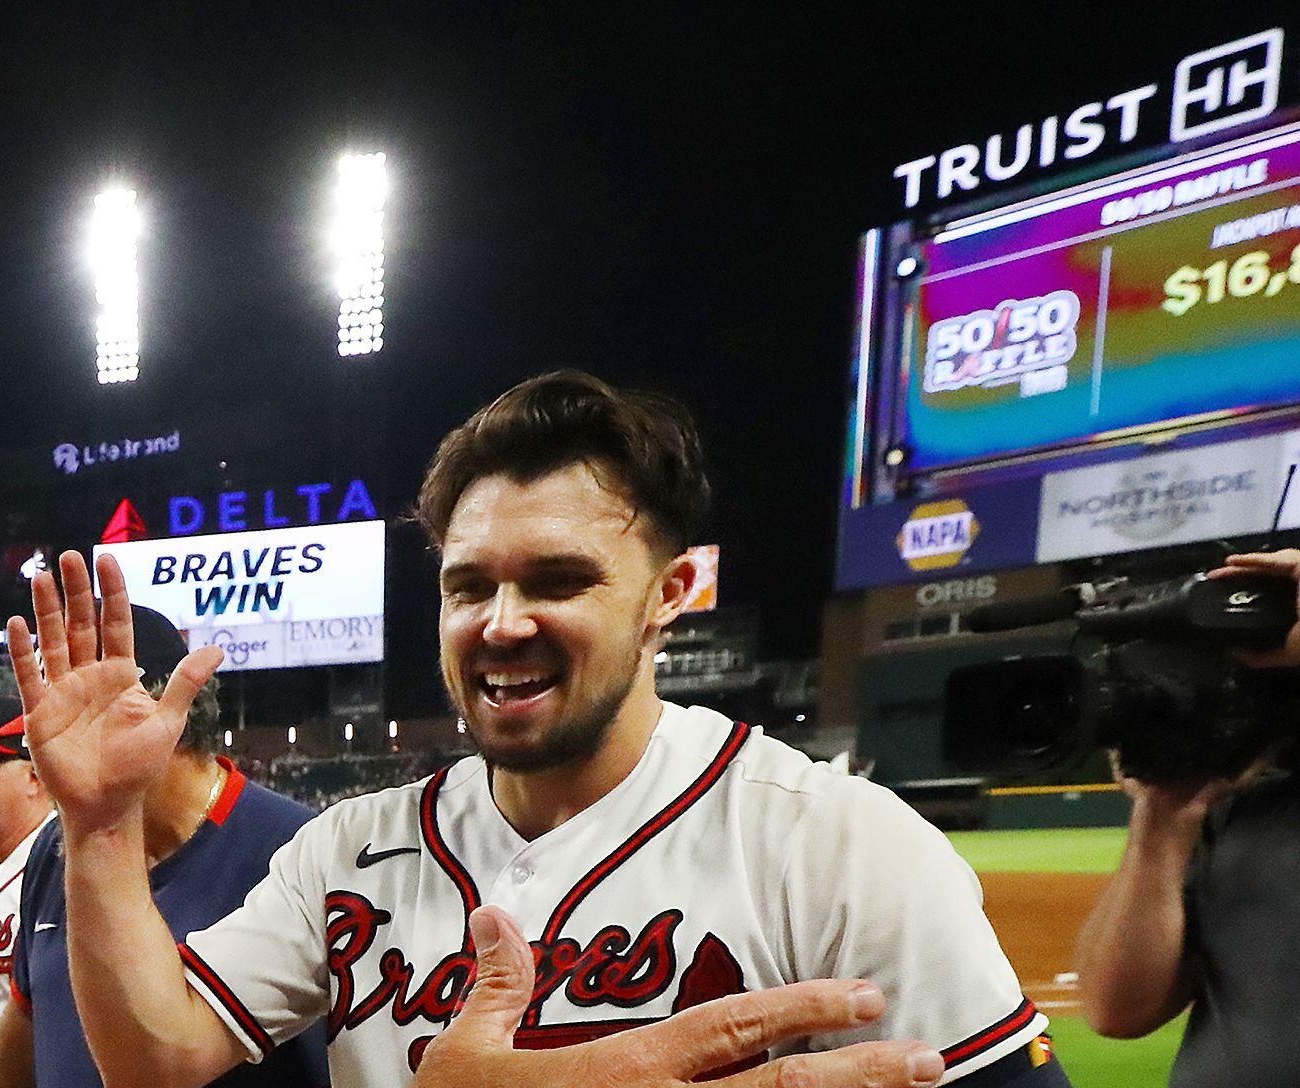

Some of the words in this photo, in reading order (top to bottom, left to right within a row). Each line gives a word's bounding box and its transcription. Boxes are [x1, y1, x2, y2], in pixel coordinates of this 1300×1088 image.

[893, 84, 1158, 208] TRUIST
[1161, 243, 1300, 317] $16,
[935, 298, 1072, 361] 50/50
[168, 479, 378, 536] DELTA
[911, 518, 967, 551] NAPA
[152, 543, 326, 585] BRAVES
[195, 581, 284, 616] WIN
[290, 616, 380, 642] EMORY
